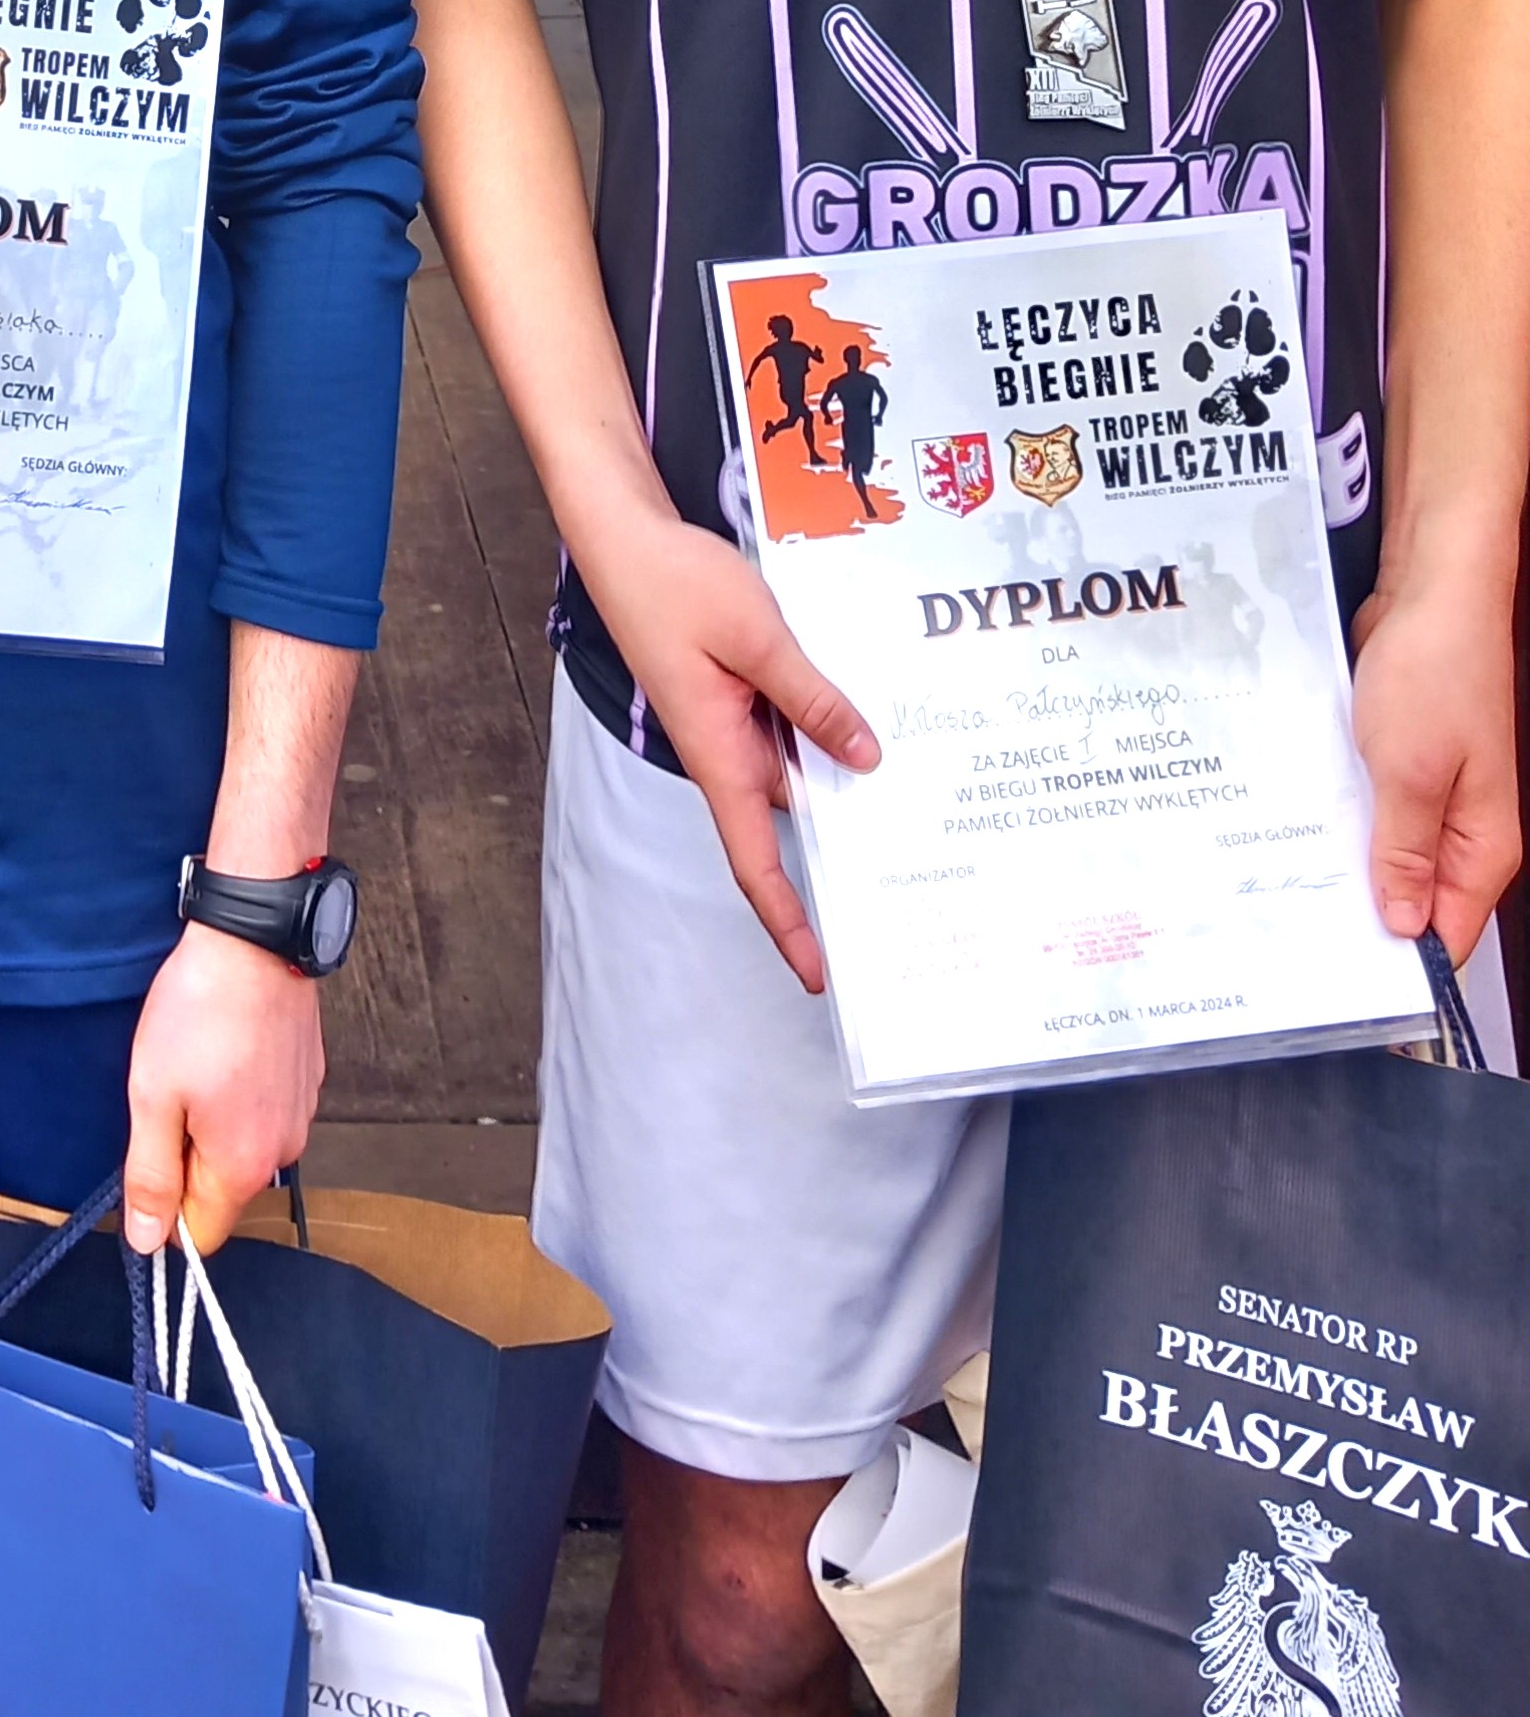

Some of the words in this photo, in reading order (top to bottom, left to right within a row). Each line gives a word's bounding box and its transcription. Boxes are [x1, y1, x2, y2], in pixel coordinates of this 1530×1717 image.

[21, 47, 110, 80] TROPEM
[21, 77, 191, 134] WILCZYM
[793, 145, 1310, 256] GRODZKA
[976, 293, 1162, 361] ŁĘCZYCA
[993, 351, 1160, 408] BIEGNIE
[1088, 409, 1189, 443] TROPEM
[21, 456, 64, 472] SĘDZIA
[68, 460, 128, 477] GŁÓWNY:
[1096, 430, 1288, 490] WILCZYM
[1227, 475, 1290, 490] WYKLĘTYCH
[917, 564, 1188, 639] DYPLOM
[1041, 645, 1080, 664] DLA
[972, 753, 997, 772] ZA
[1000, 744, 1070, 769] ZAJĘCIE
[1115, 730, 1193, 755] MIEJSCA
[955, 787, 973, 803] W
[979, 779, 1037, 801] BIEGU
[1041, 767, 1125, 794] TROPEM
[1128, 756, 1223, 783] WILCZYM
[943, 811, 1022, 835] PAMIĘCI
[1026, 798, 1129, 827] ŻOŁNIERZY
[1133, 783, 1248, 812] WYKLĘTYCH
[1215, 831, 1262, 848] SĘDZIA
[1137, 1007, 1144, 1020] 1
[1148, 1001, 1197, 1018] MARCA
[1200, 996, 1234, 1012] 2024
[1218, 1284, 1369, 1354] SENATOR
[1375, 1328, 1419, 1366] RP
[1157, 1322, 1476, 1449] PRZEMYSŁAW
[1099, 1369, 1530, 1560] BŁASZCZYK
